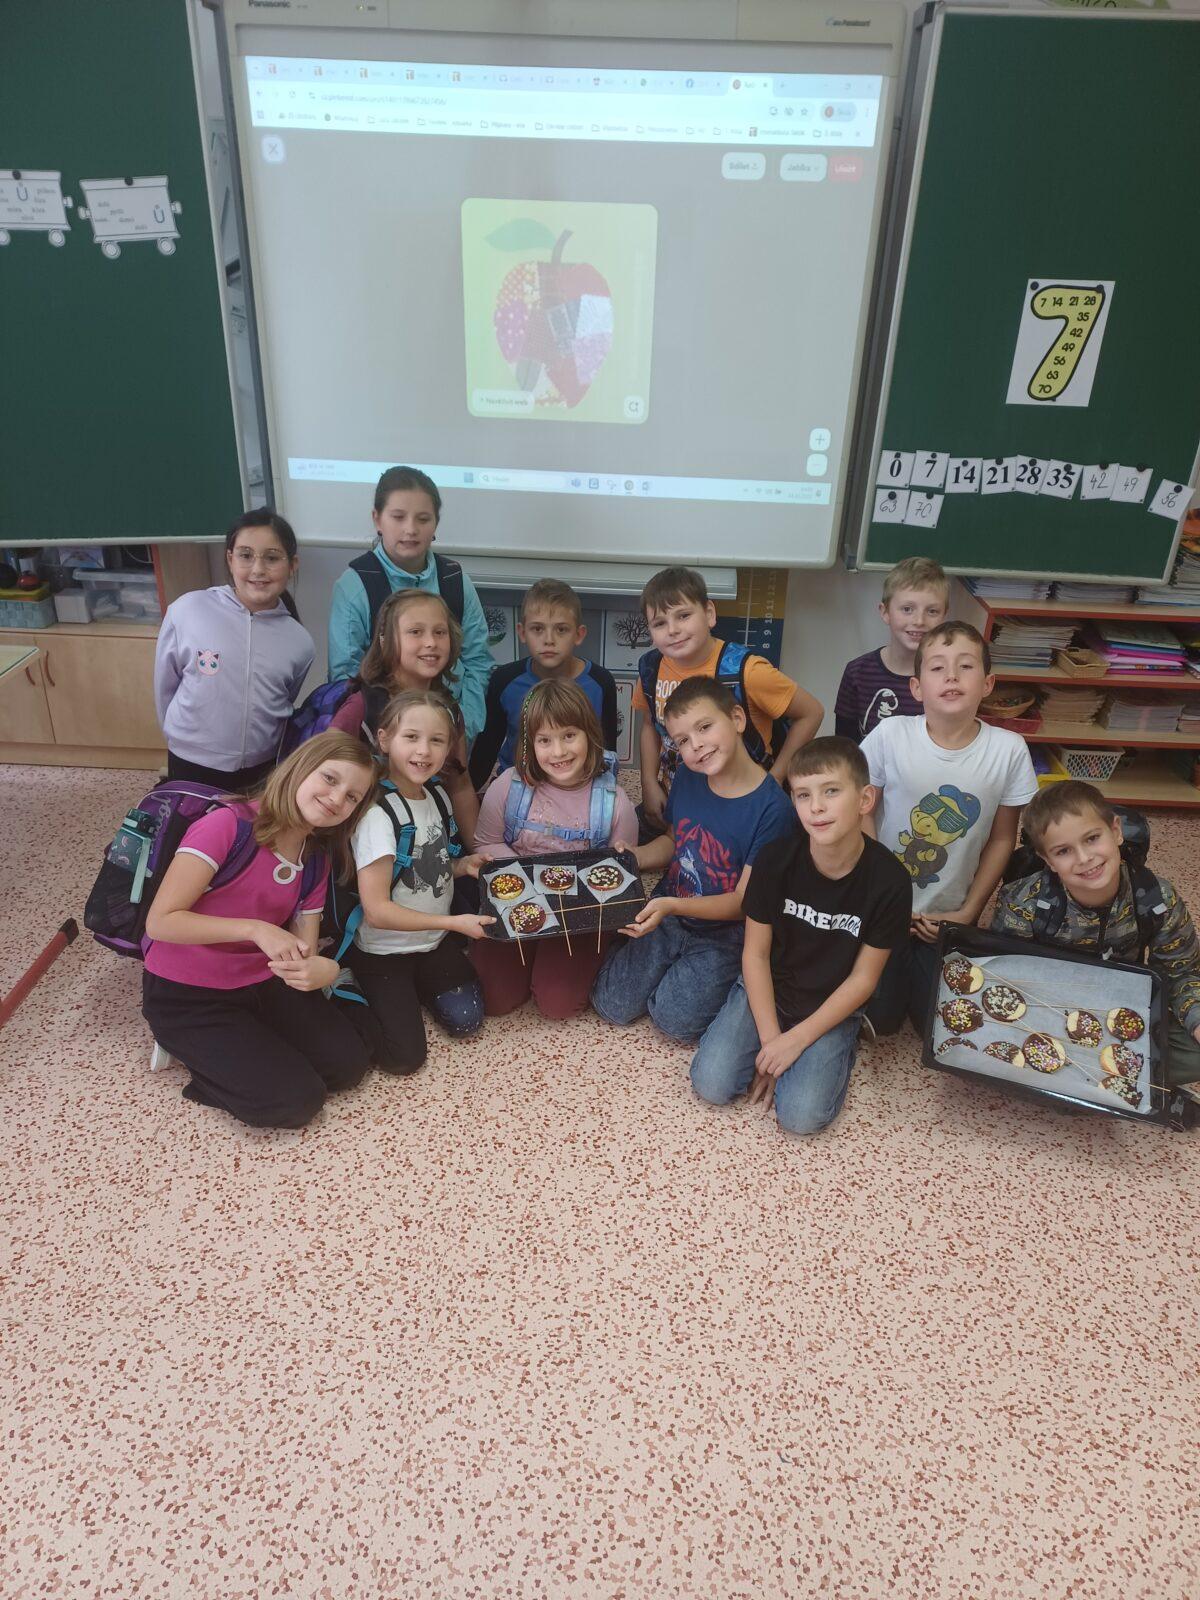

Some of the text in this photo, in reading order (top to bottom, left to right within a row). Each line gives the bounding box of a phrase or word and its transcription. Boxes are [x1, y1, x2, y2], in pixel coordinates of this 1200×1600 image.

[248, 0, 291, 8] Panasonic
[1040, 296, 1097, 308] 7 14 21 28
[1076, 312, 1090, 321] 35
[1070, 328, 1083, 337] 42
[1061, 343, 1075, 352] 49
[1053, 356, 1066, 365] 56
[1046, 371, 1059, 380] 63
[1038, 384, 1052, 393] 70
[889, 459, 1075, 489] 0 7 14 21 28 35
[1090, 471, 1178, 508] 42 49 56
[879, 499, 933, 519] 63 70
[764, 612, 773, 624] 10
[783, 898, 832, 931] BIKE
